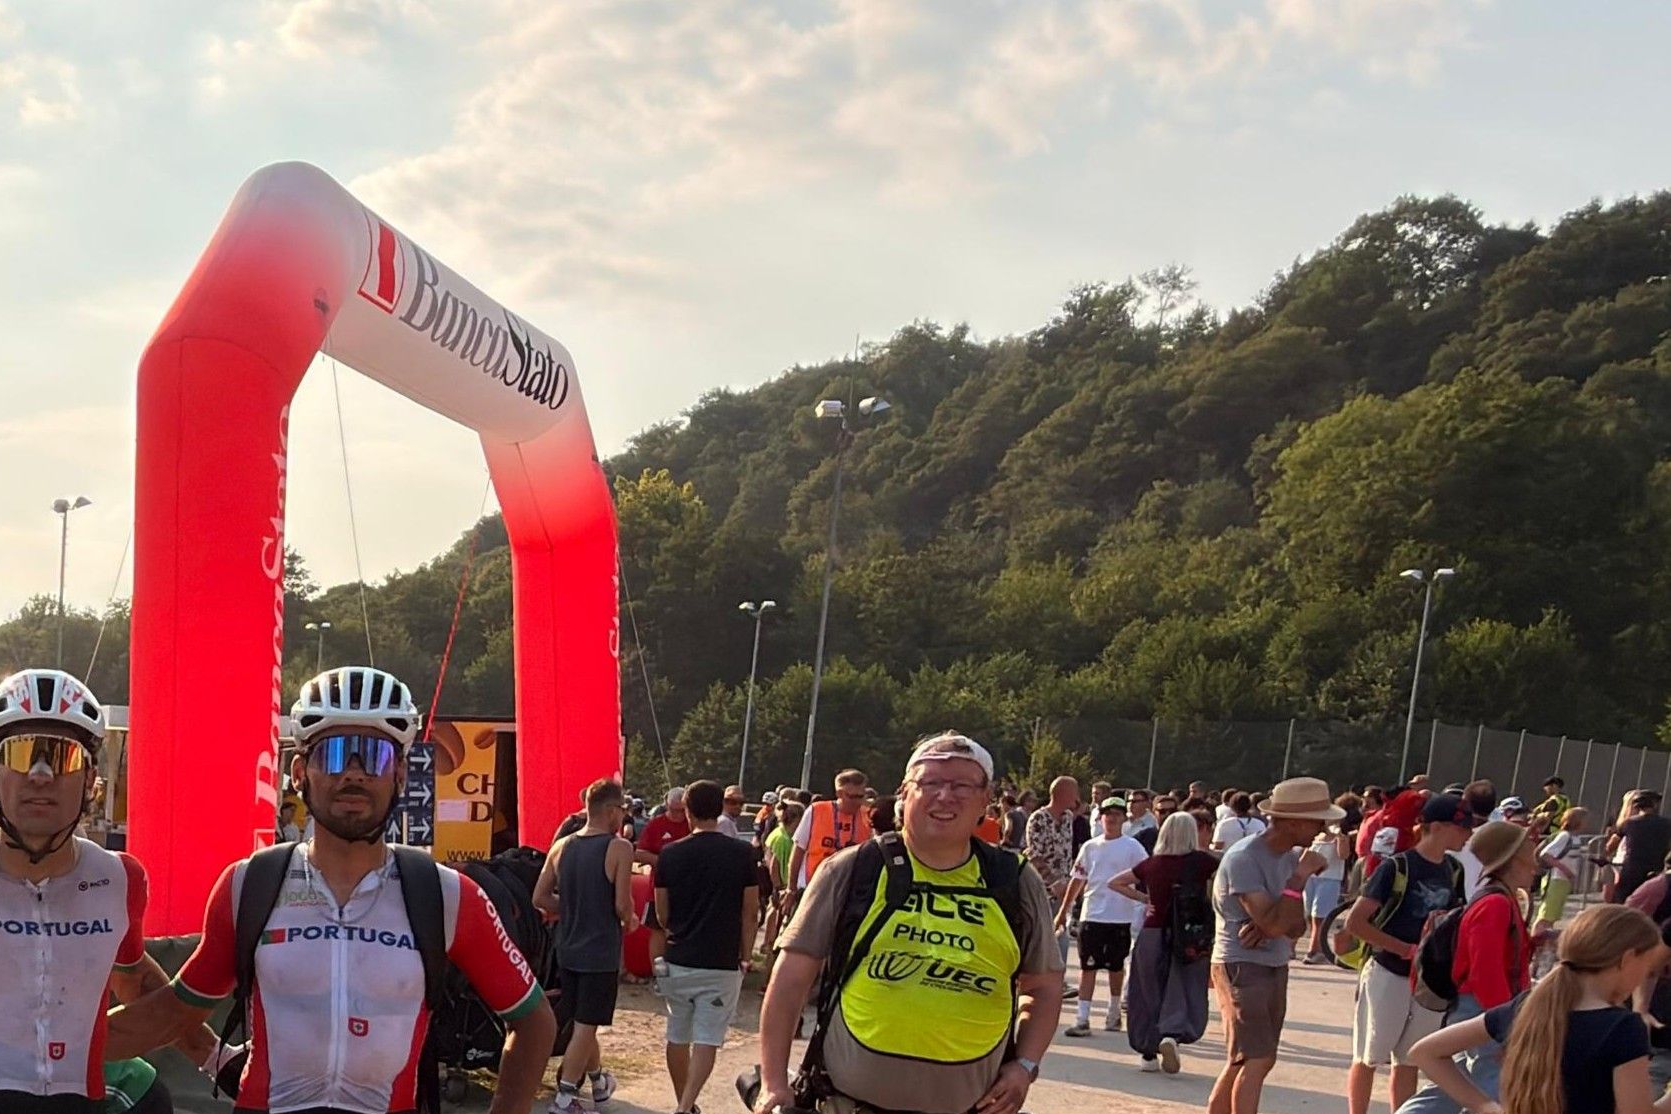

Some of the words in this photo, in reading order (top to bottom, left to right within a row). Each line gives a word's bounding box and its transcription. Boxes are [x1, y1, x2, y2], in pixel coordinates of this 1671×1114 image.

[398, 243, 570, 410] BancaStato
[287, 925, 416, 951] PORTUGA
[477, 887, 536, 985] PORTUGAL
[893, 923, 975, 952] PHOTO
[926, 959, 998, 992] UEC
